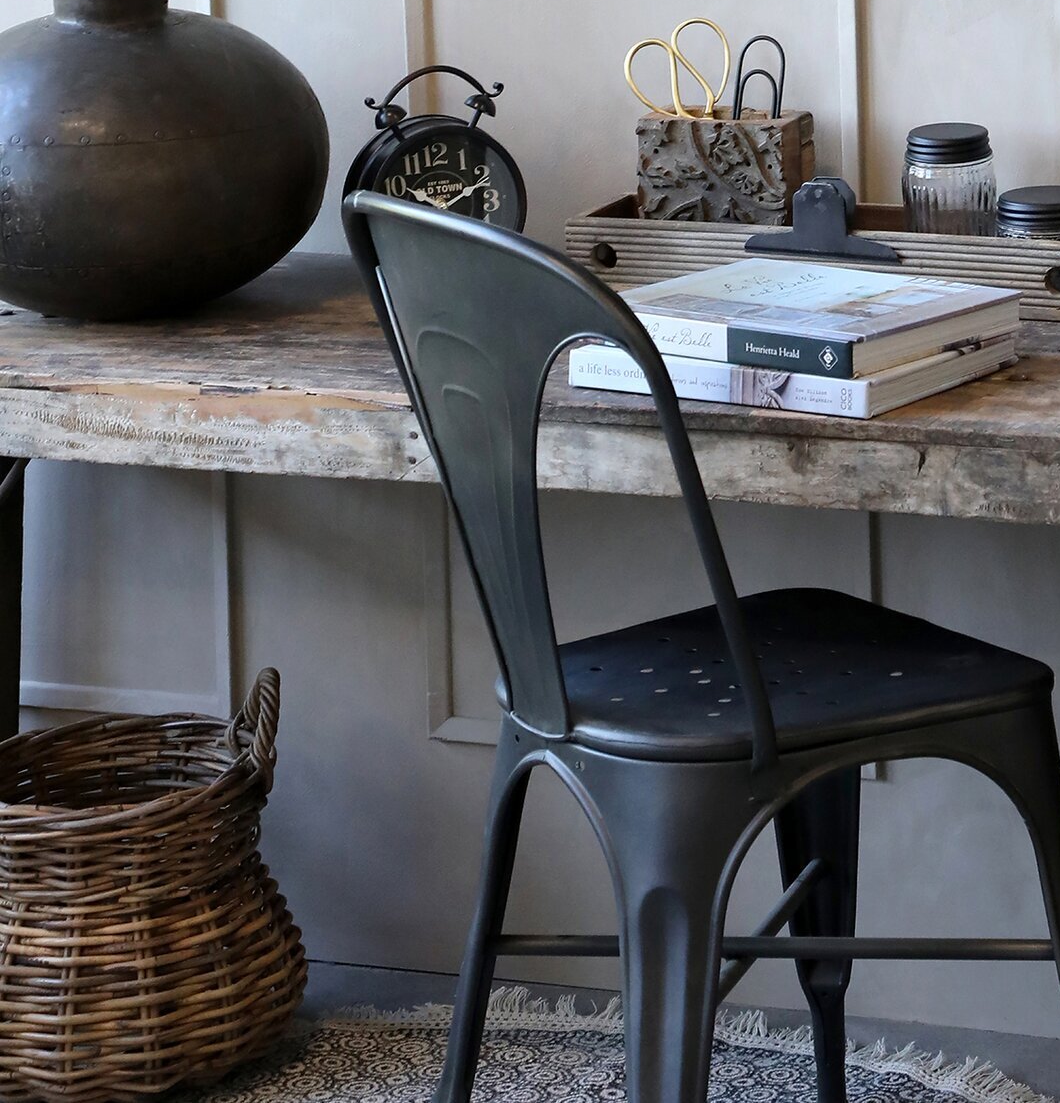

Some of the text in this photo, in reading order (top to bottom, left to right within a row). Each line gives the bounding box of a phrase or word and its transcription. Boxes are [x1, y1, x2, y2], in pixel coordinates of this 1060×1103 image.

[403, 152, 421, 176] 11
[423, 142, 448, 168] 12
[457, 148, 467, 171] 1
[384, 175, 407, 197] 10
[474, 164, 491, 187] 2
[436, 182, 463, 194] TOWN
[483, 189, 500, 212] 3
[678, 328, 713, 348] Belle
[745, 342, 800, 359] Henrietta Heald
[578, 365, 584, 373] a
[587, 363, 601, 375] life
[604, 365, 621, 376] less
